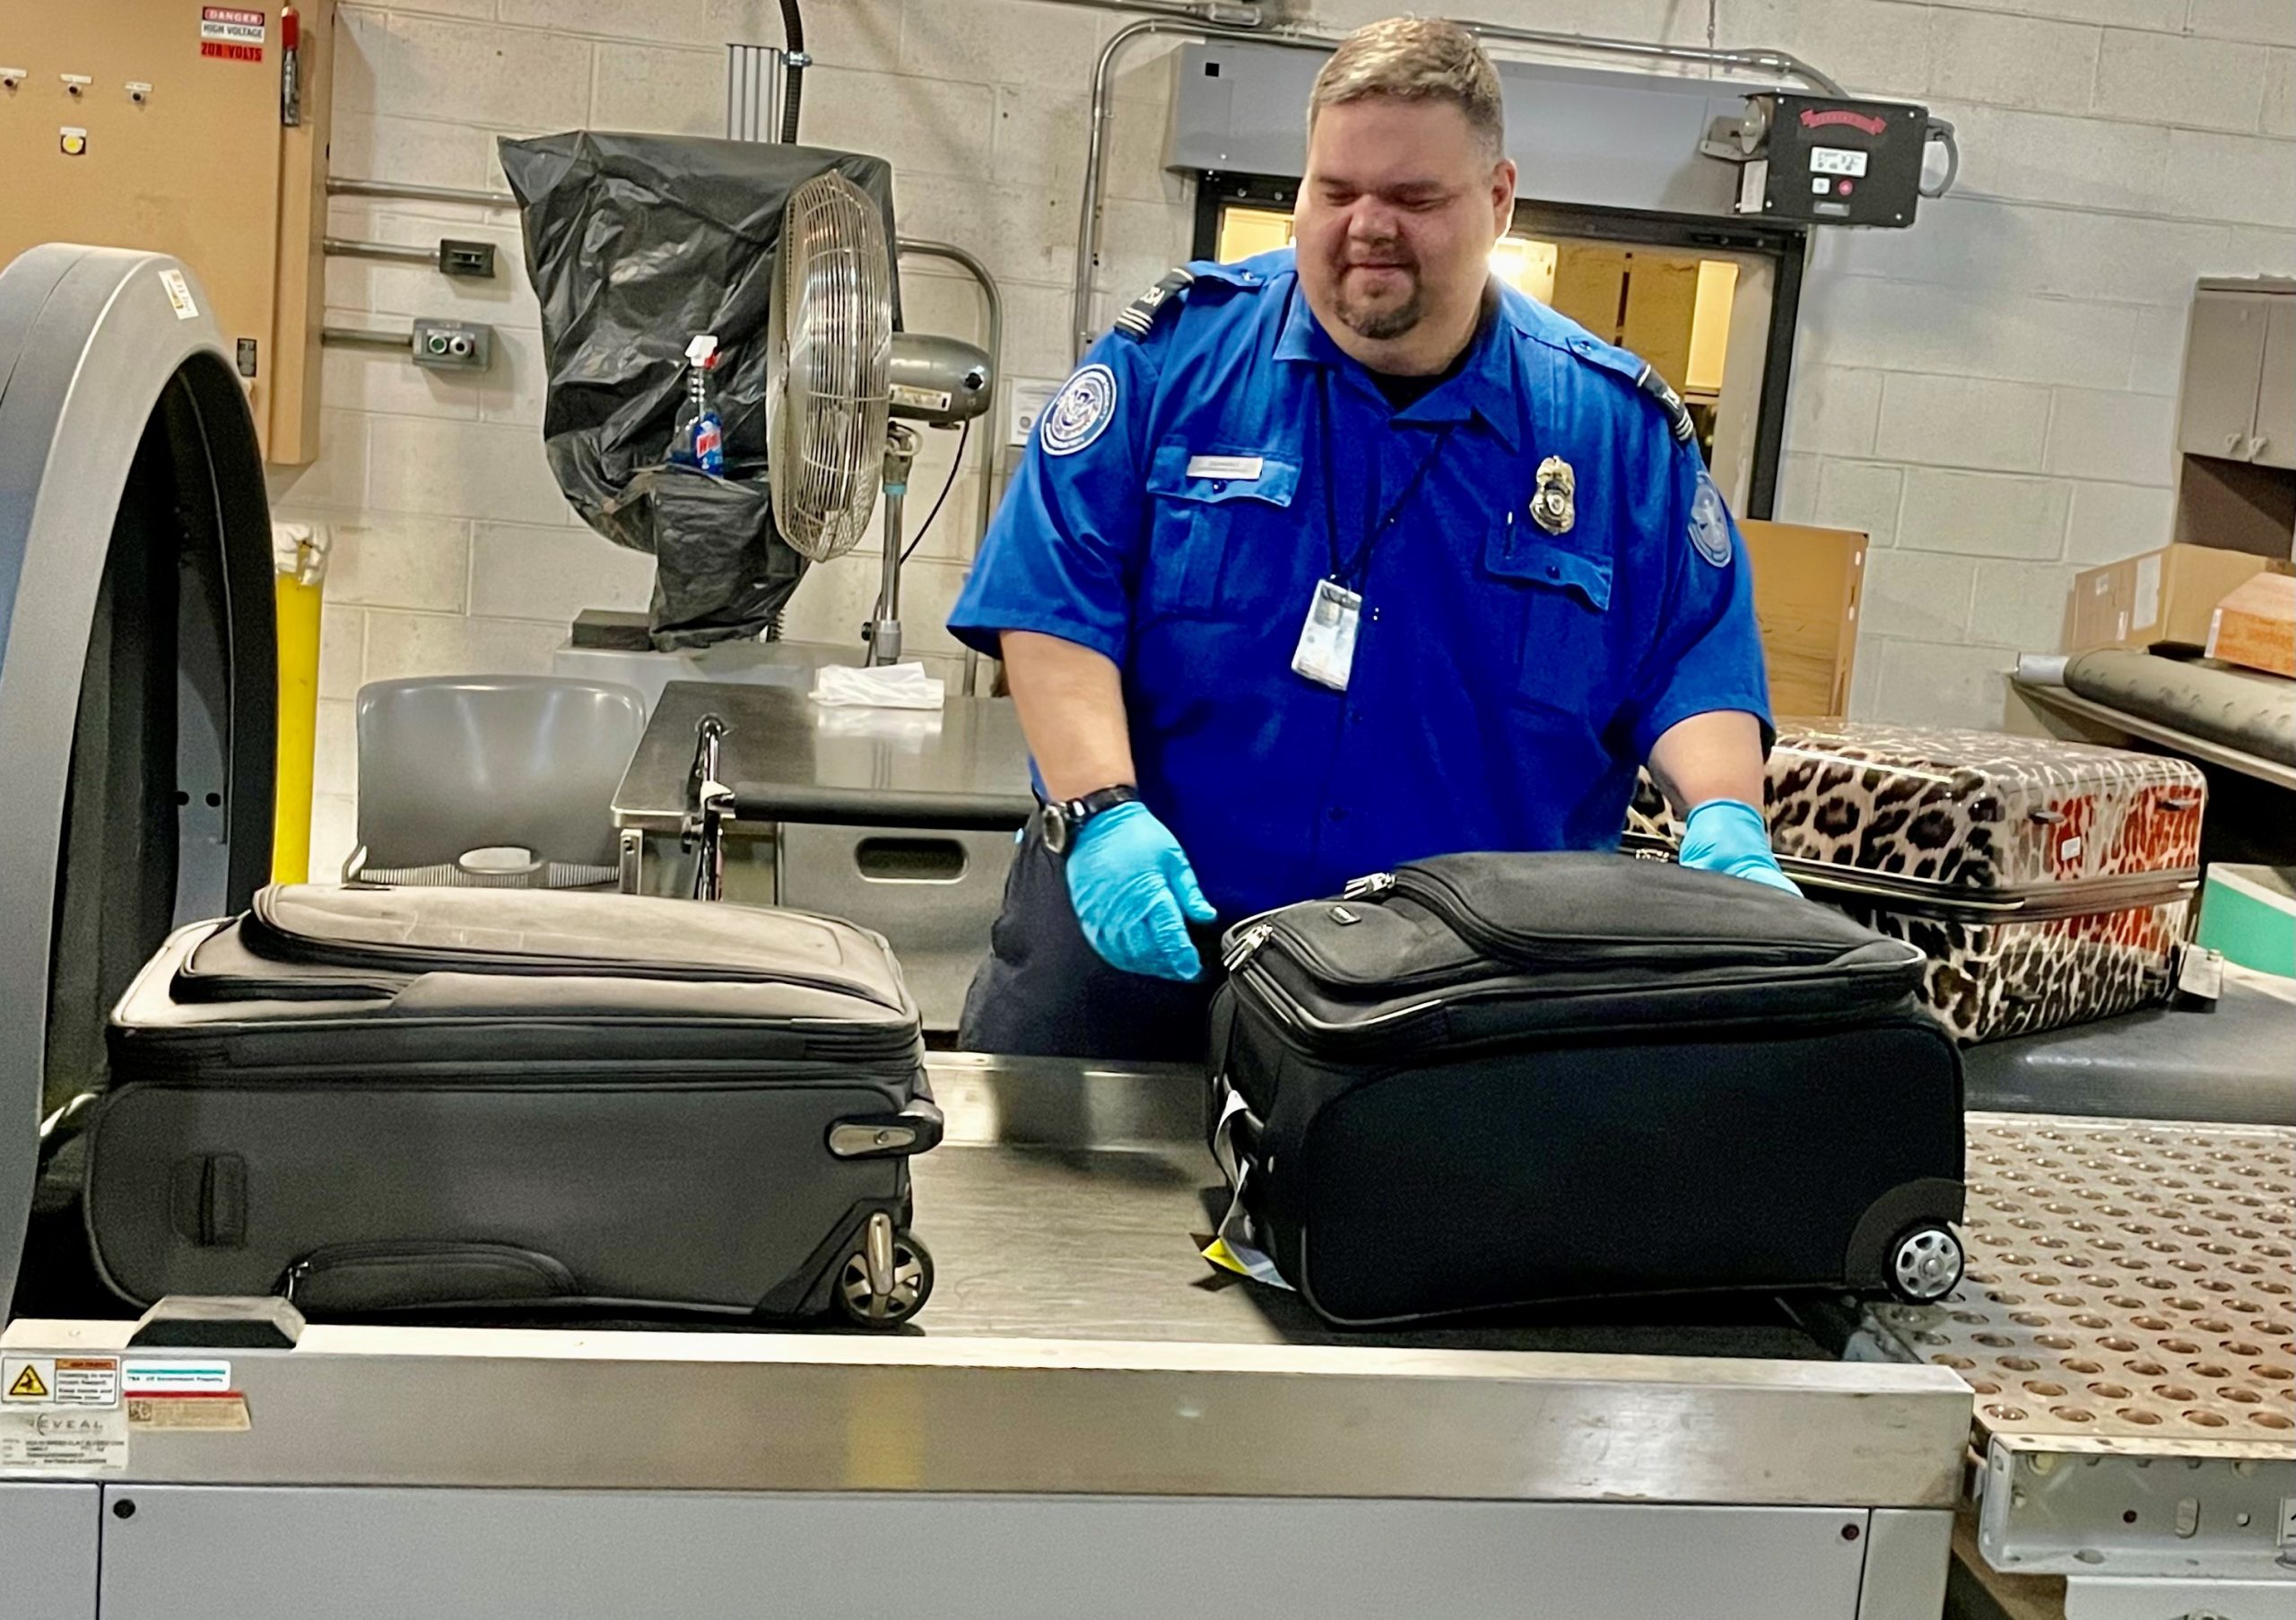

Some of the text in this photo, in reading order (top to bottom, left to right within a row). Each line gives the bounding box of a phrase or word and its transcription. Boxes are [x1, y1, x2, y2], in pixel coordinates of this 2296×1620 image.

[209, 9, 258, 23] DANGER
[204, 24, 262, 39] HIGH VOLTAGE
[228, 45, 262, 62] VOLTS
